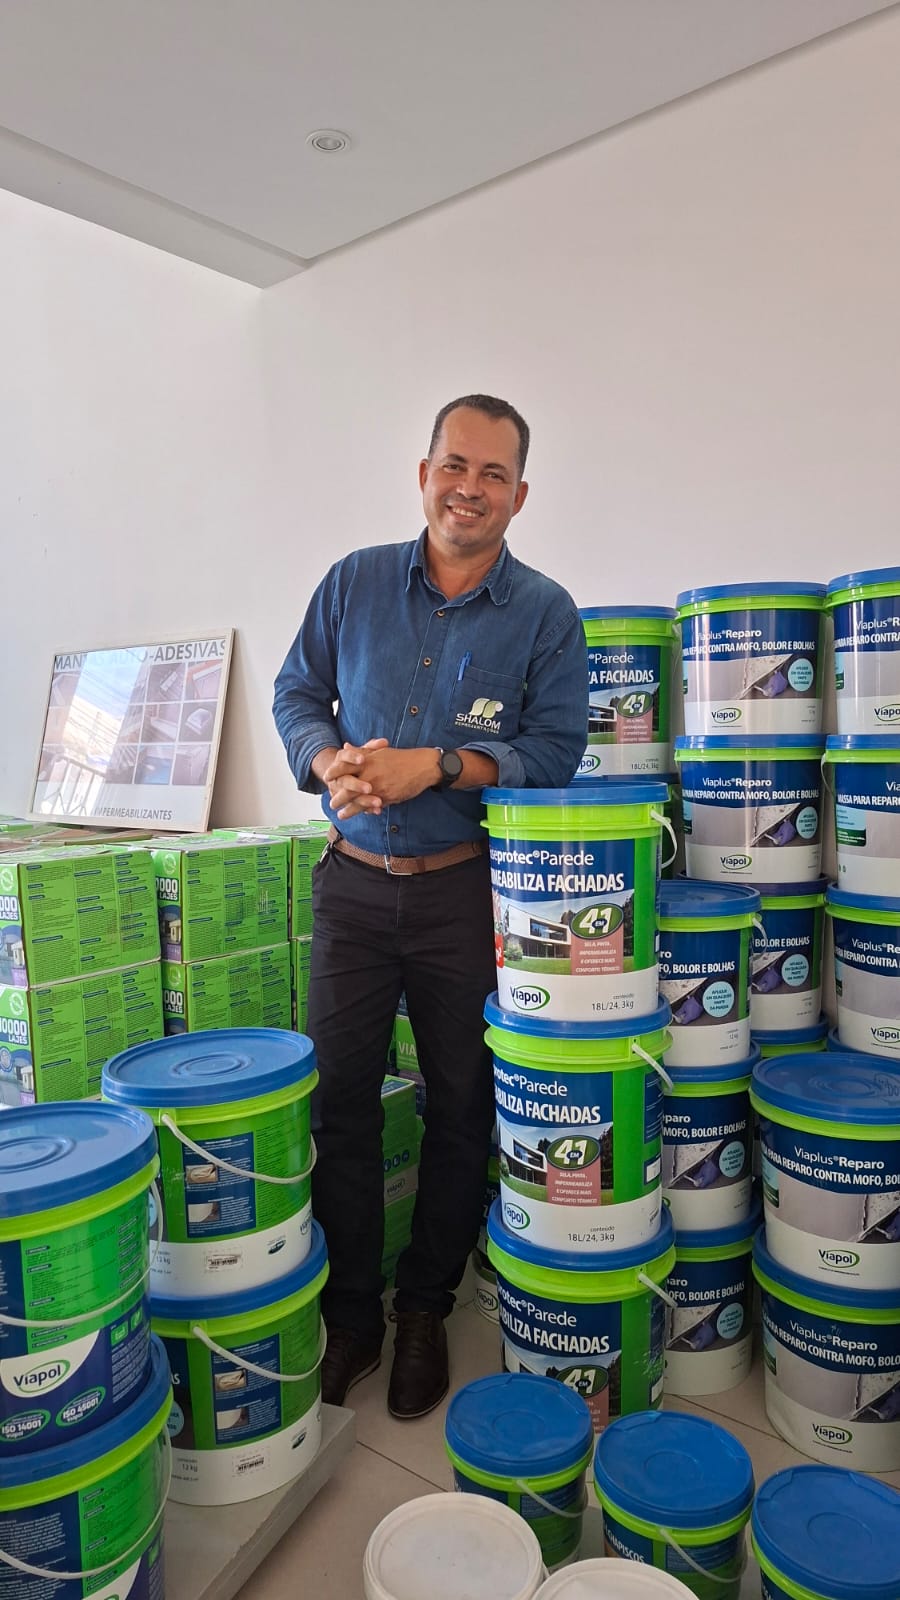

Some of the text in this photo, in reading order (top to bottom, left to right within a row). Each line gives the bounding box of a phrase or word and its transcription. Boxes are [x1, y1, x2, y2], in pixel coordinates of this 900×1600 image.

[725, 629, 762, 639] Reparo
[709, 643, 734, 653] CONTRA
[762, 641, 787, 650] BOLOR
[788, 641, 792, 649] E
[793, 641, 815, 650] BOLHAS
[600, 669, 654, 684] FACHADAS
[456, 713, 501, 730] SHALOM
[711, 711, 736, 720] Viapol
[735, 778, 772, 789] Reparo
[716, 790, 745, 800] CONTRA
[772, 790, 795, 800] BOLOR
[796, 790, 800, 799] E
[853, 794, 871, 805] PARA
[872, 796, 900, 806] REPAR
[720, 857, 747, 867] Viapol
[548, 873, 625, 893] FACHADAS
[755, 936, 810, 947] BOLOR E BOLHAS
[673, 964, 701, 974] BOLOR
[702, 964, 706, 973] E
[708, 961, 735, 972] BOLHAS
[866, 955, 898, 969] CONTRA
[510, 986, 541, 1005] Viapol
[8, 1034, 28, 1045] LAJES
[525, 1099, 601, 1124] FACHADAS
[663, 1114, 691, 1124] paro
[691, 1127, 718, 1138] BOLOR
[719, 1126, 723, 1135] E
[838, 1156, 885, 1171] Reparo
[782, 1157, 813, 1176] REPARO
[814, 1168, 851, 1184] CONTRA
[853, 1174, 883, 1187] MOFO,
[818, 1249, 853, 1265] Viapol
[668, 1281, 744, 1302] OFO, BOLOR E BOLHAS
[533, 1327, 610, 1354] FACHADAS
[832, 1336, 878, 1351] Reparo
[778, 1328, 807, 1352] REPARO
[808, 1344, 845, 1363] CONTRA
[846, 1355, 876, 1368] MOFO,
[13, 1364, 61, 1387] Viapol
[63, 1408, 76, 1420] ISO
[2, 1426, 16, 1435] ISO
[812, 1423, 845, 1441] Viapol
